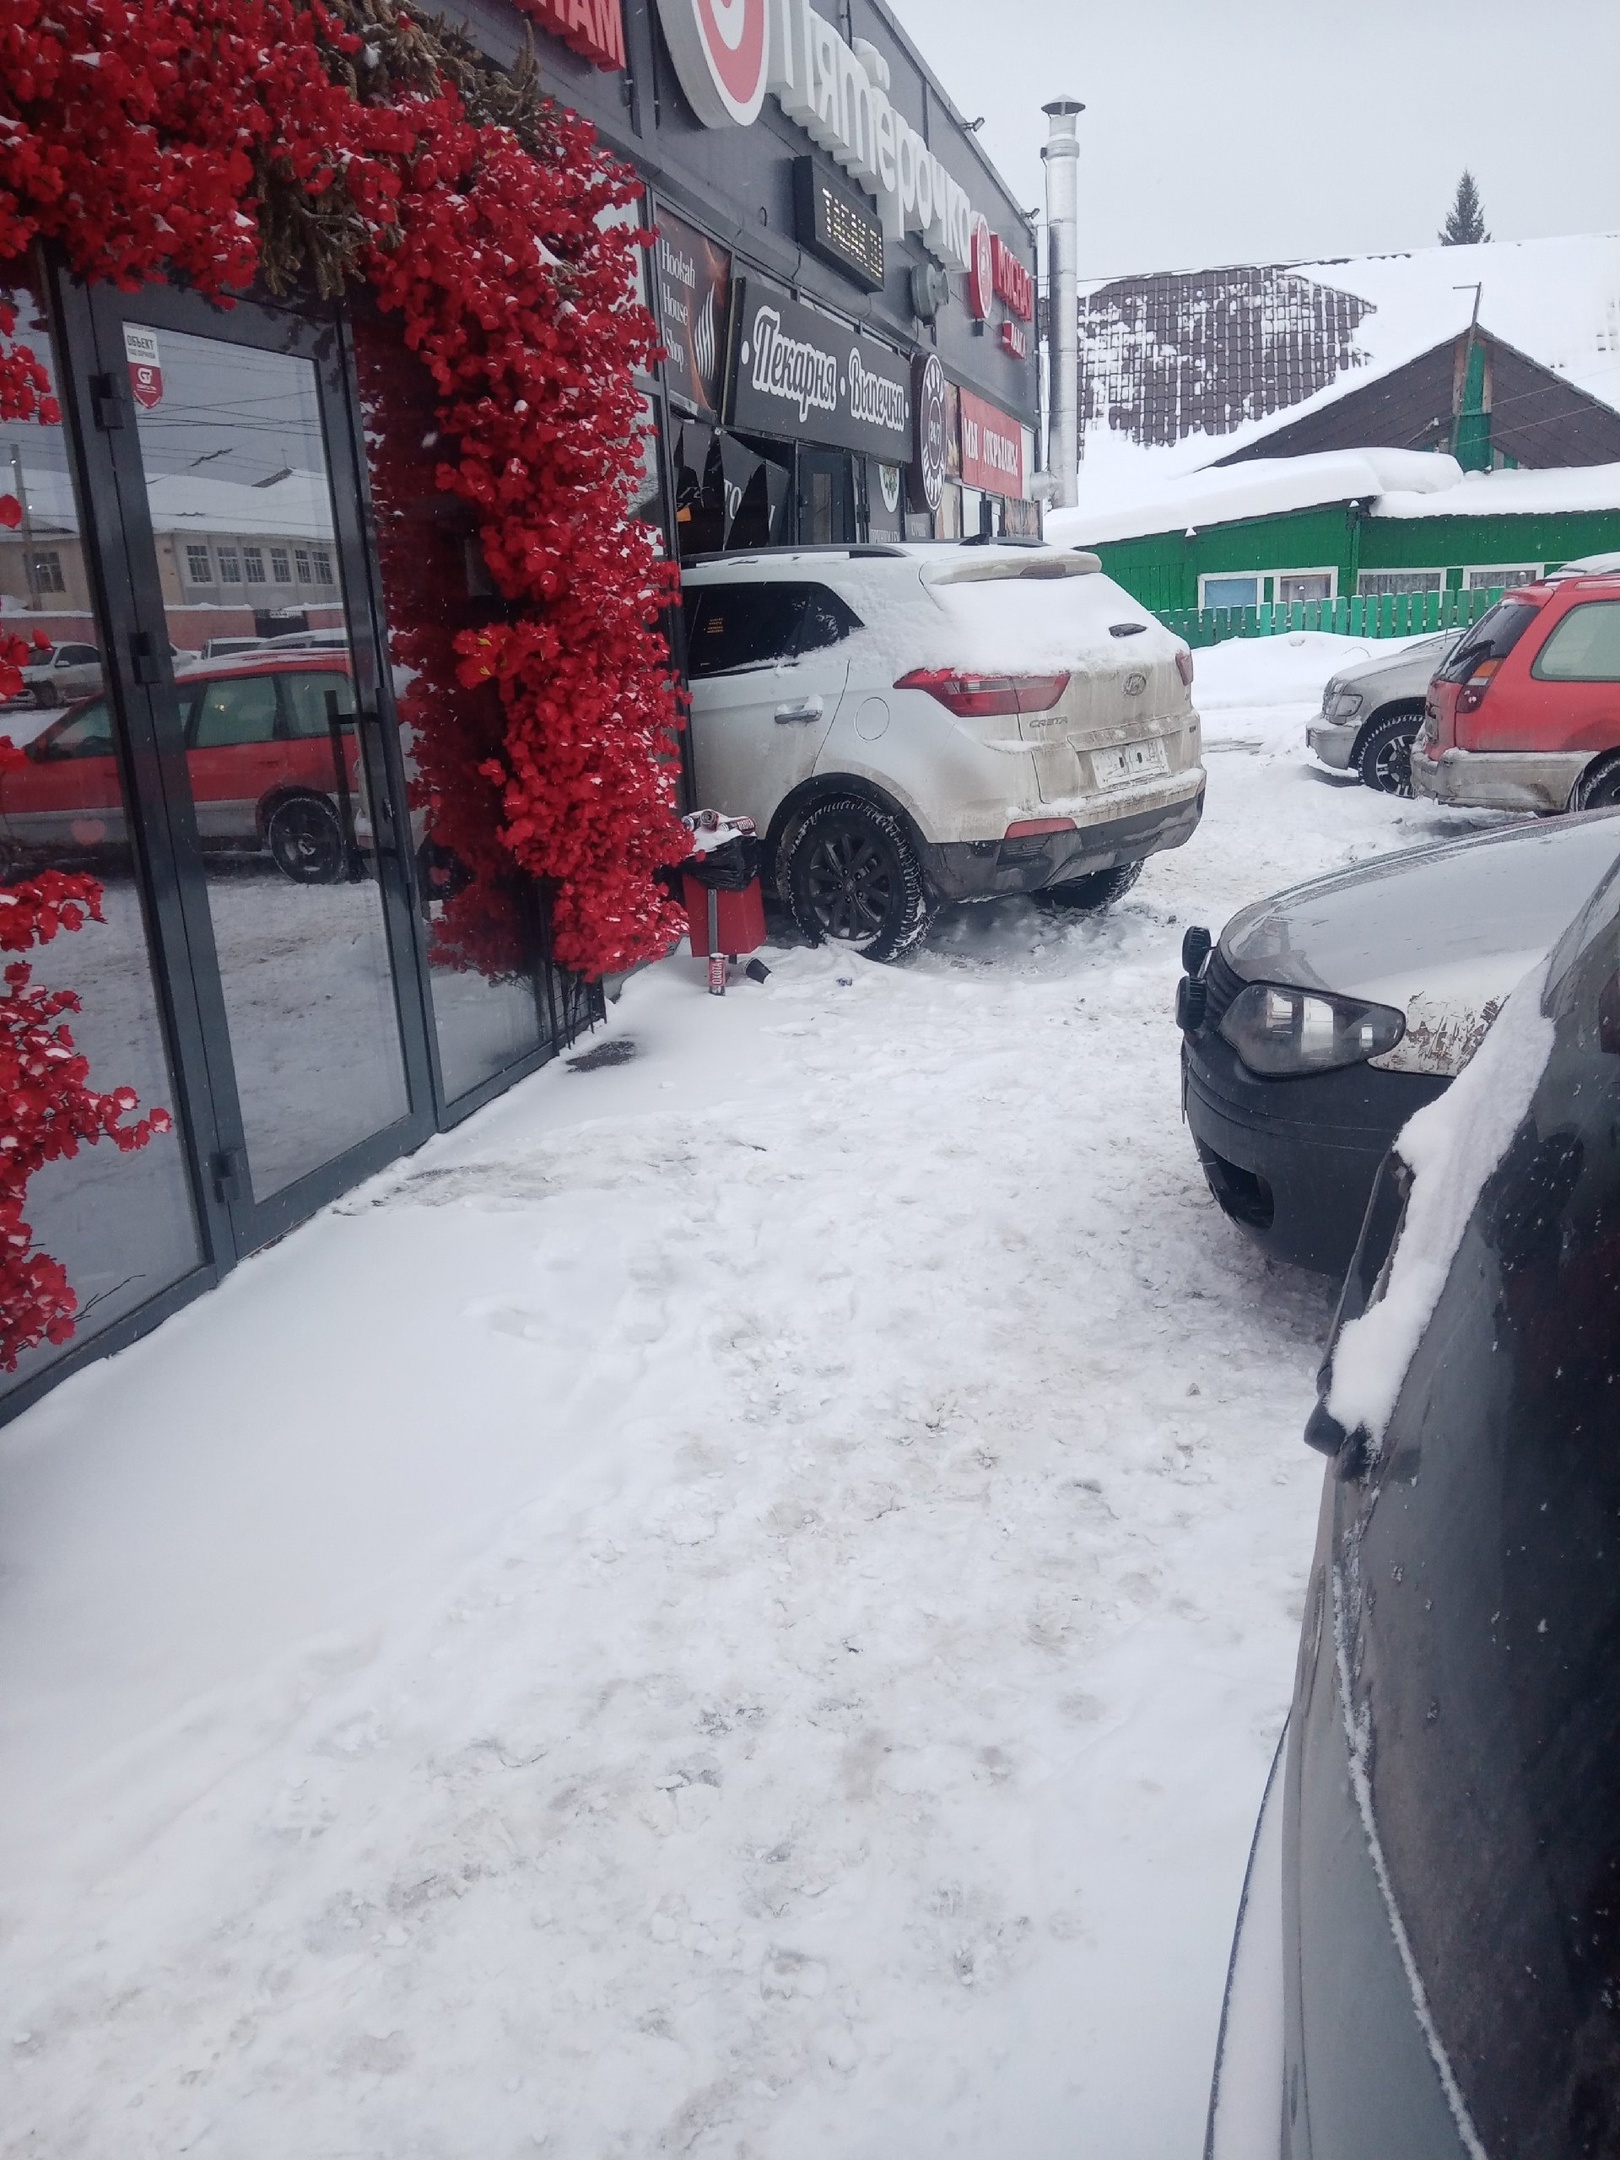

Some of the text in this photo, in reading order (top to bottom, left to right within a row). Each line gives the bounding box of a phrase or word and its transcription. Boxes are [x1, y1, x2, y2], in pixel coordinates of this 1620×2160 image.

[661, 238, 696, 289] Hookah
[662, 282, 689, 326] House
[665, 326, 685, 373] Shop
[753, 305, 905, 432] Пекарня Выпечка
[963, 417, 979, 461] МЫ
